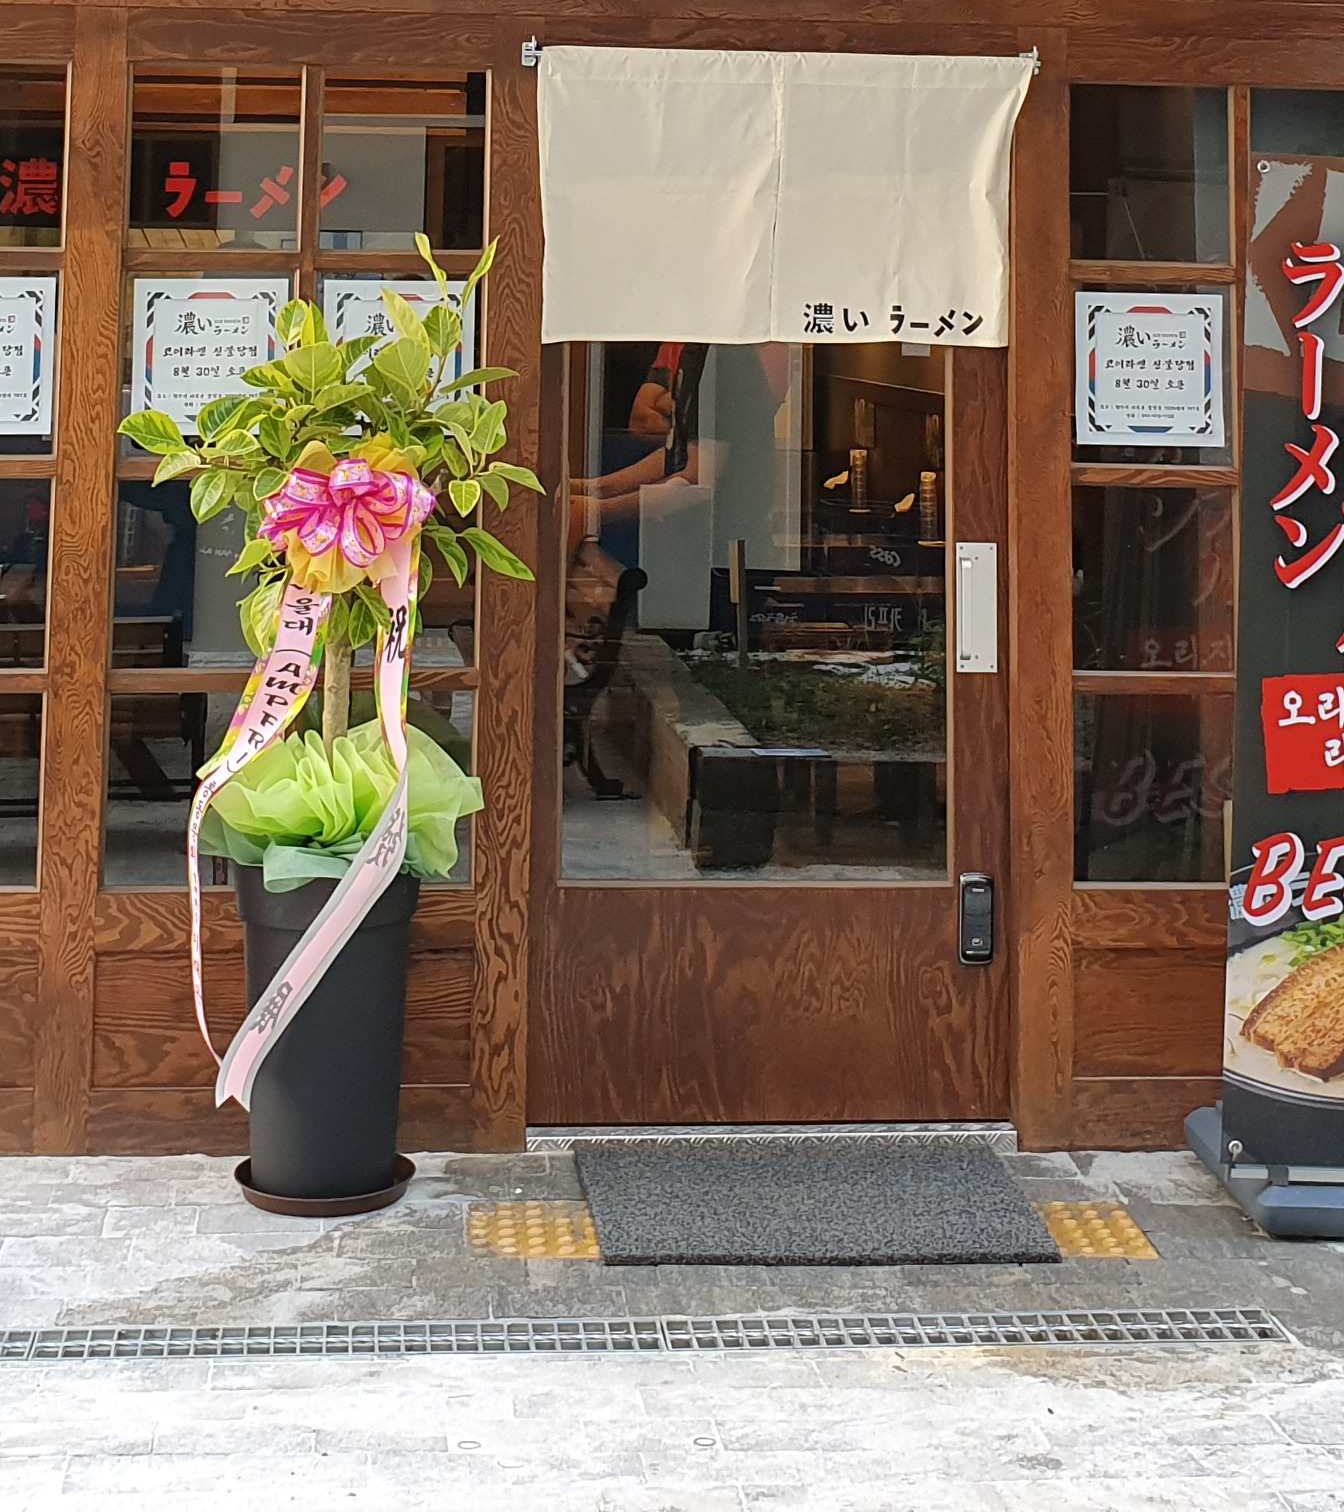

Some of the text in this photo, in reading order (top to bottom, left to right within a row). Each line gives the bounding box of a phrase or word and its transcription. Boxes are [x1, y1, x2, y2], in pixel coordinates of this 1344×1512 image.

[803, 302, 984, 338] 濃い ラーメン
[283, 584, 320, 636] 울대
